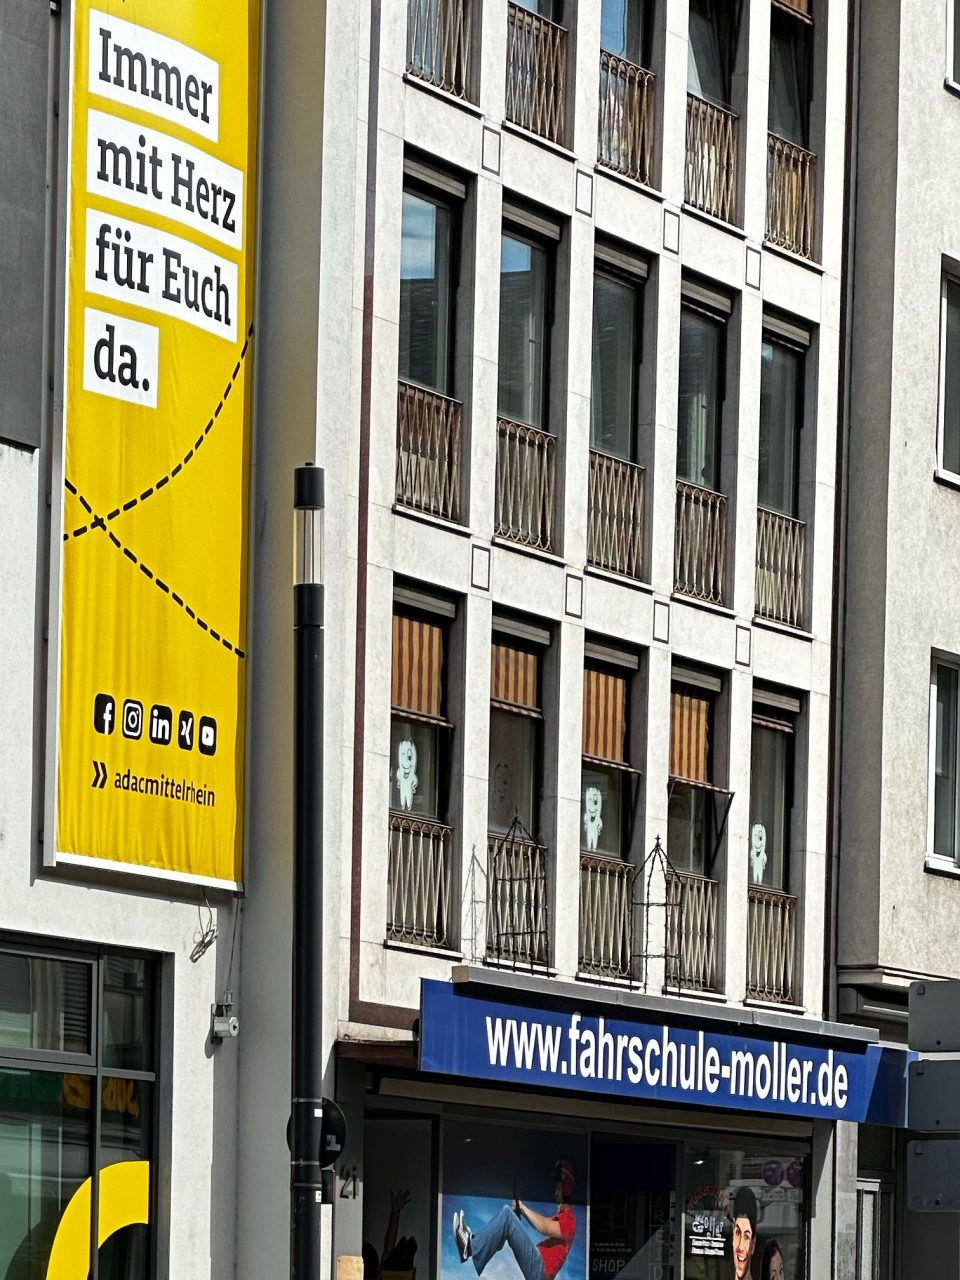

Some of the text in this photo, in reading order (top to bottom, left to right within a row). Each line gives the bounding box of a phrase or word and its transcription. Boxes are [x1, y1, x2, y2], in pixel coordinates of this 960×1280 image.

[98, 27, 213, 125] Immer
[96, 133, 237, 234] mit Herz
[94, 222, 232, 327] für Euch
[93, 323, 150, 392] da.
[114, 768, 216, 807] adacmittelrhein
[484, 1010, 850, 1110] www.fahrschule-moller.de
